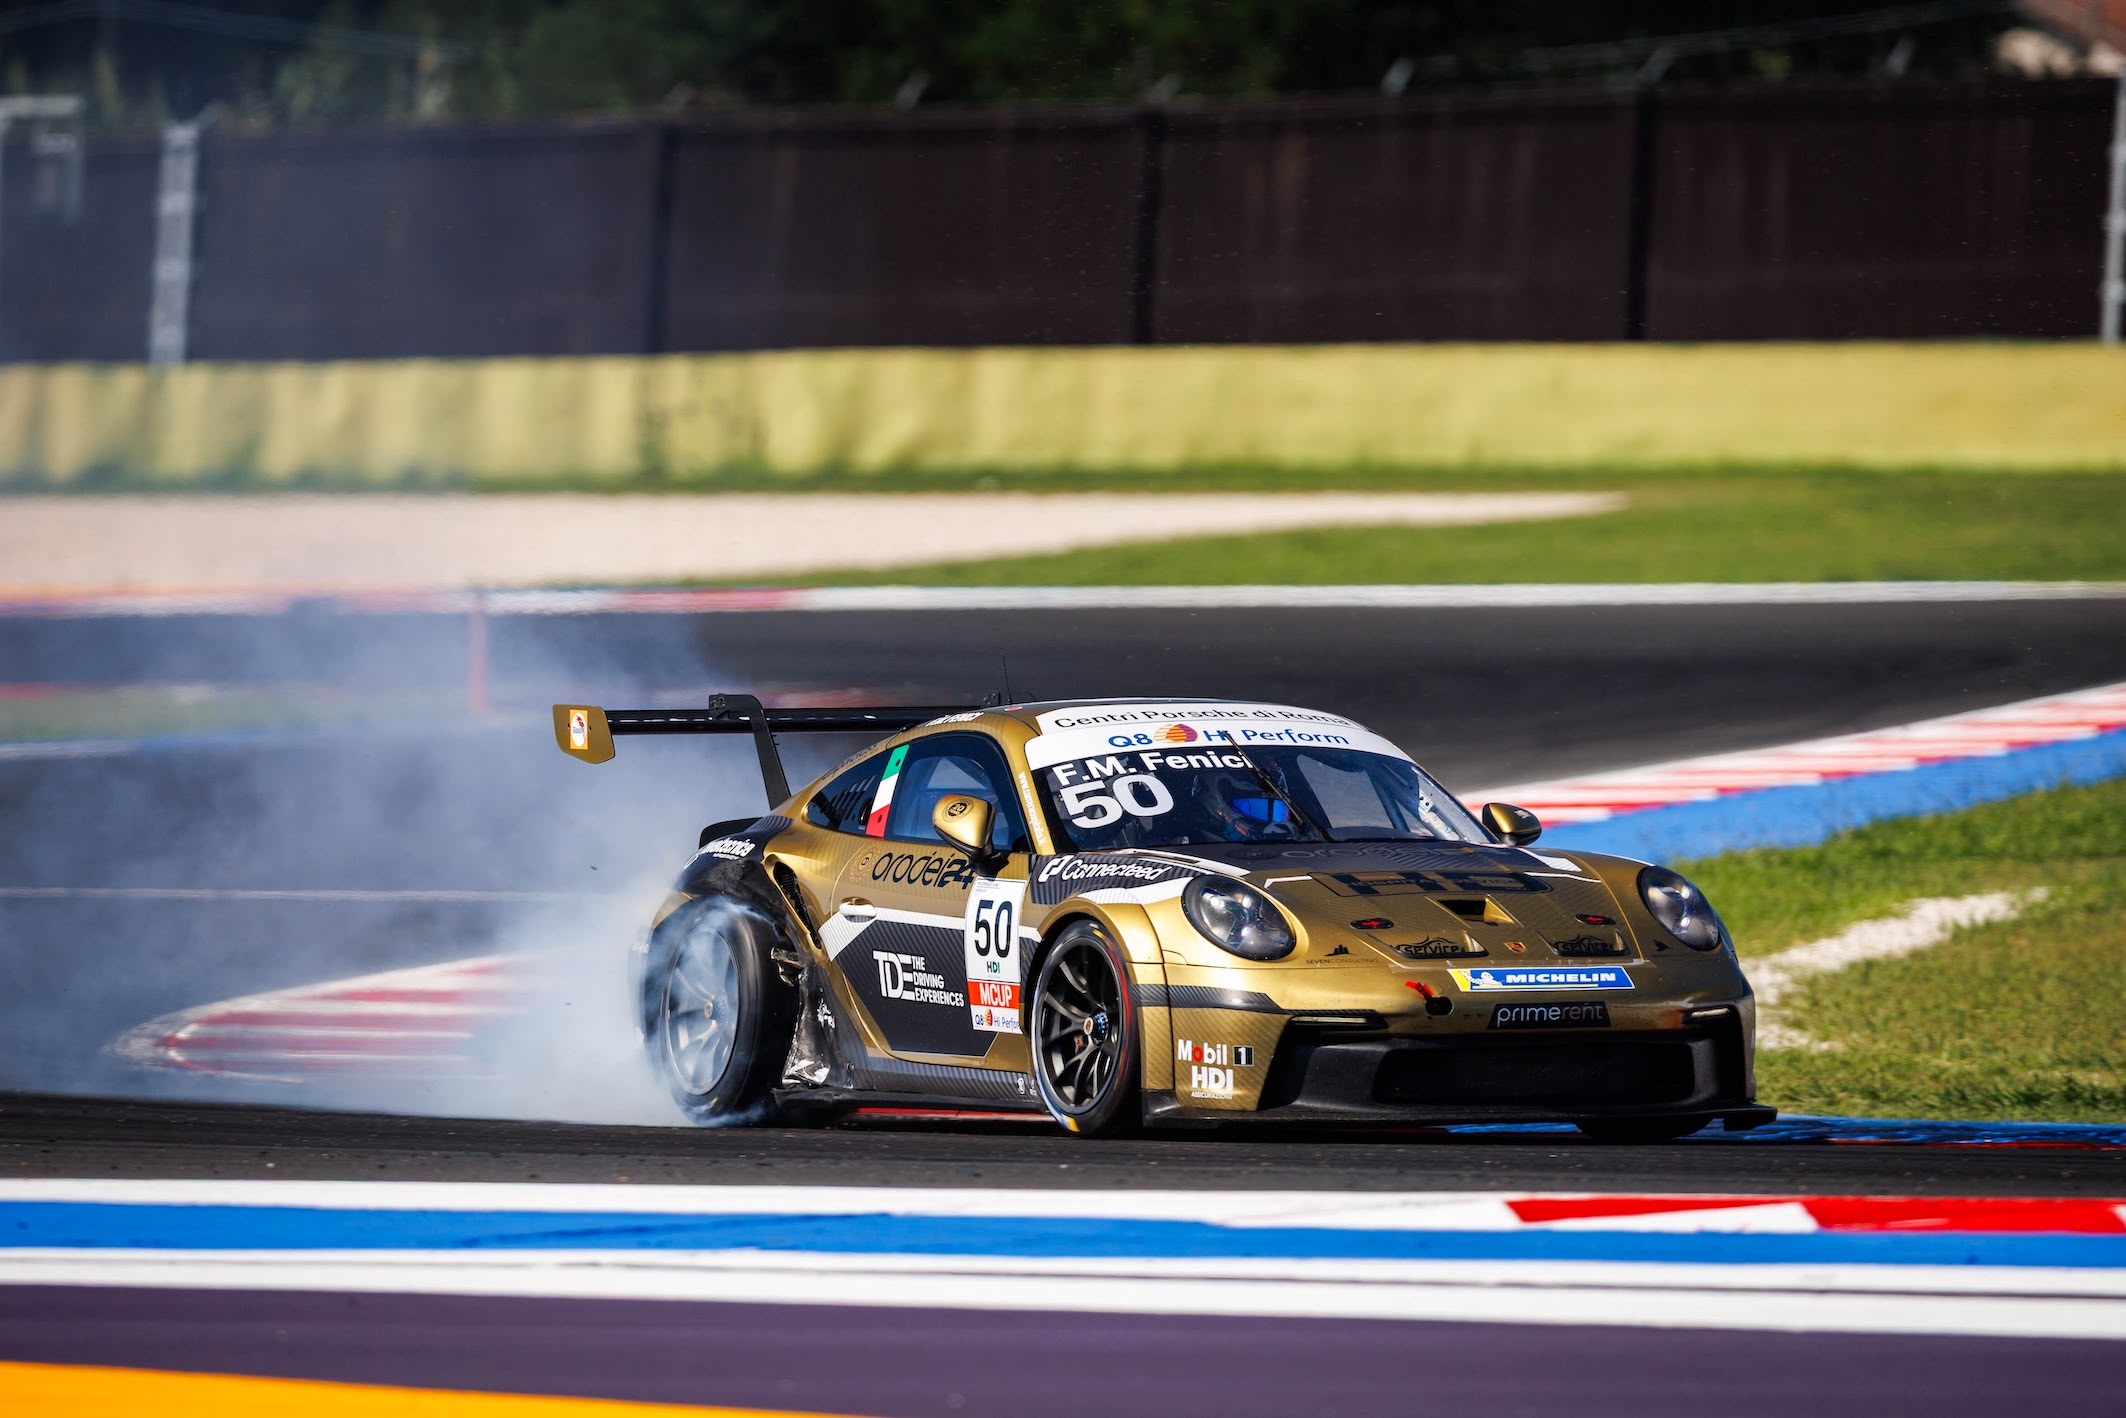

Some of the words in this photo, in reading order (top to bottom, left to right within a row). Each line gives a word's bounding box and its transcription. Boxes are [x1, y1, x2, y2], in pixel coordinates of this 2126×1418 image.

[1054, 711, 1139, 728] Centri
[1141, 709, 1248, 719] Porsche
[1252, 710, 1276, 719] di
[1277, 710, 1350, 726] Roma
[1108, 733, 1153, 748] Q8
[1241, 728, 1350, 745] Perform
[1052, 755, 1138, 786] F.M.
[1139, 750, 1254, 772] Fenici
[1059, 774, 1175, 829] 50
[1061, 859, 1173, 881] Connecteed
[974, 899, 1013, 959] 50
[911, 955, 926, 971] THE
[986, 960, 1001, 974] HDI
[872, 950, 916, 1002] TDE
[913, 971, 945, 989] DRIVING
[1505, 972, 1617, 984] MICHELIN
[914, 987, 965, 1008] EXPERIENCES
[979, 983, 1013, 1008] MCUP
[974, 1014, 985, 1027] Q8
[993, 1016, 1001, 1027] Hi
[1496, 1003, 1604, 1028] primerent
[1177, 1038, 1228, 1066] Mobil
[1191, 1065, 1234, 1092] HDI
[1190, 1091, 1233, 1100] ASSICURAZIONI
